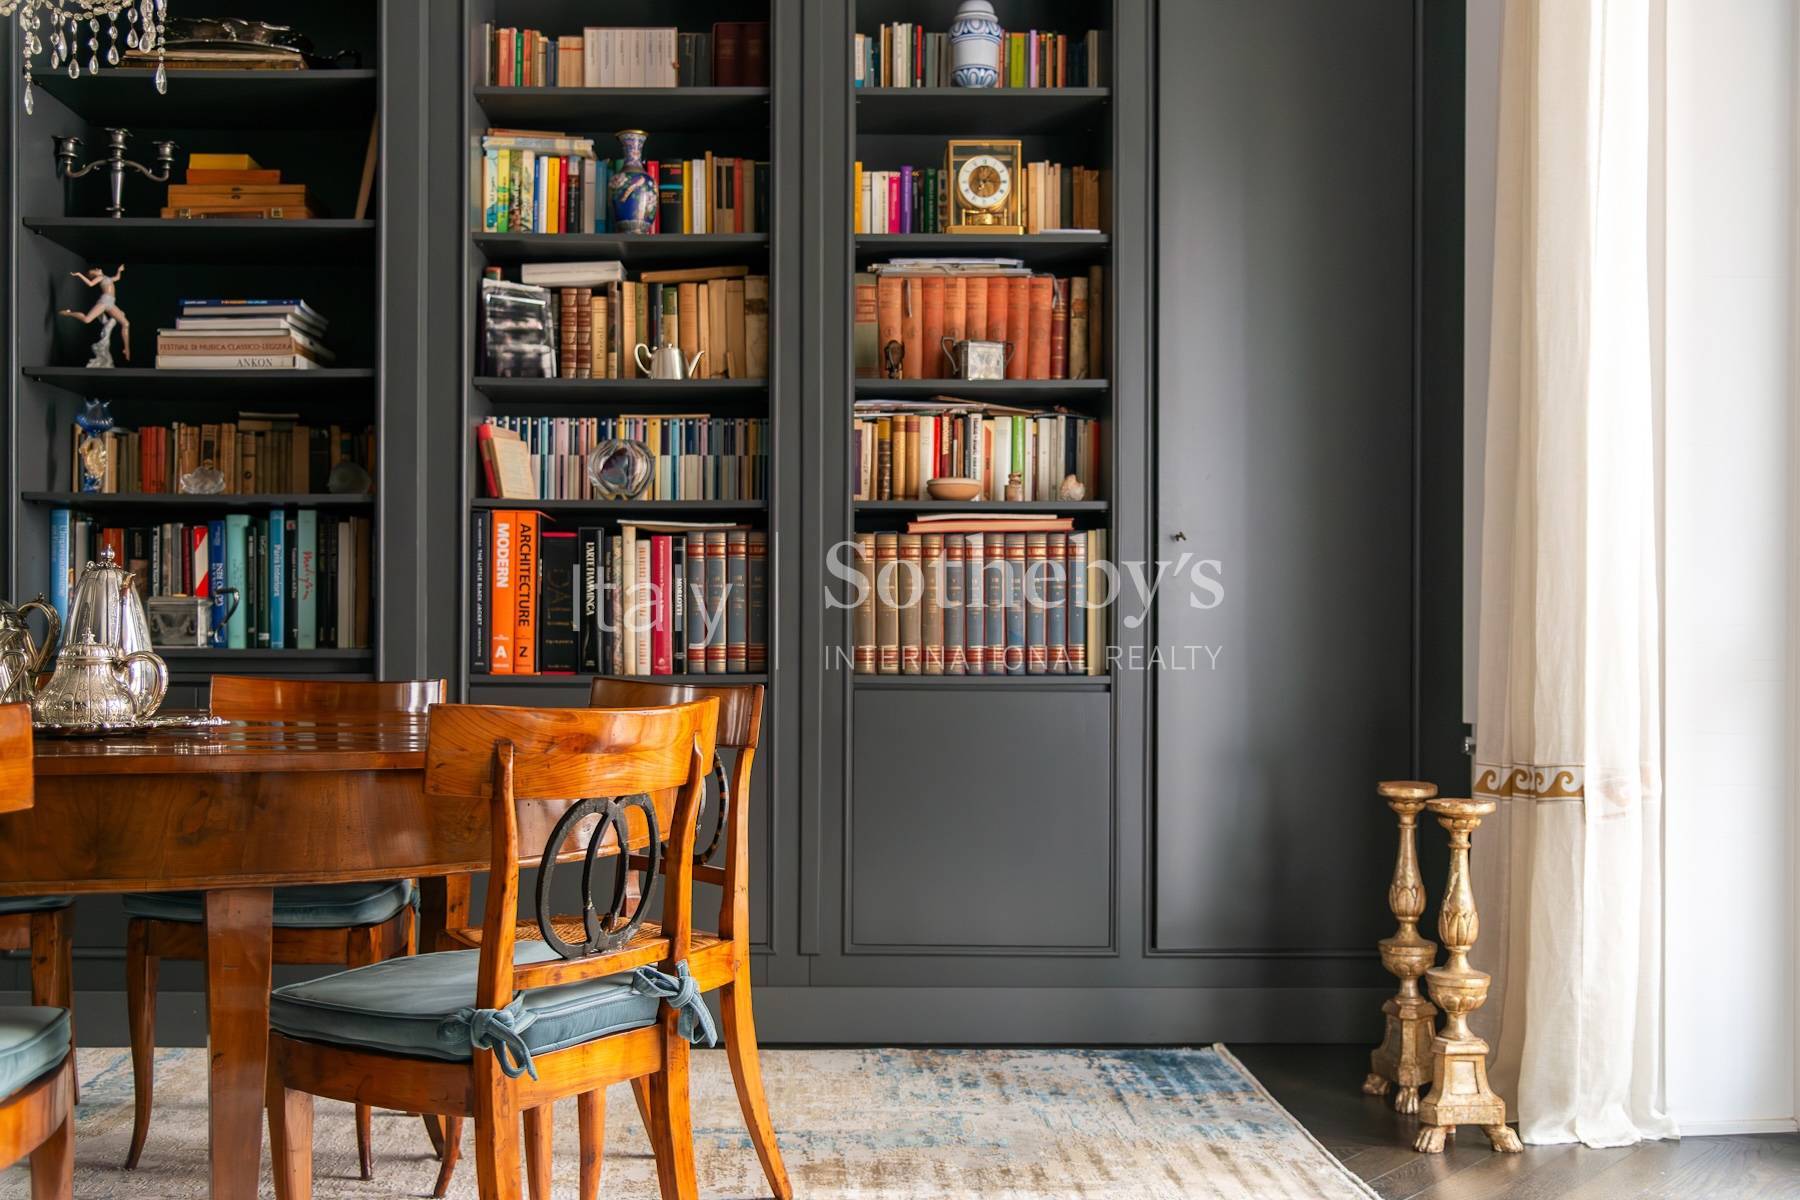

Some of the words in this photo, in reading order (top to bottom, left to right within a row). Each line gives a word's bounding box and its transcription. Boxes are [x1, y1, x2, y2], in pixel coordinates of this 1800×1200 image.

[160, 343, 189, 351] FESTIVAL
[191, 343, 198, 351] DI
[199, 343, 227, 351] MUSICA
[227, 343, 293, 351] CLASSICO-LEGGERA
[236, 358, 273, 368] ANKON
[273, 544, 282, 564] Paris
[496, 522, 510, 589] MODERN
[585, 541, 595, 566] L'ARTE
[273, 565, 282, 597] Interiors
[518, 523, 533, 628] ARCHITECTURE
[585, 567, 595, 616] FIAMMINGA
[495, 645, 508, 658] A
